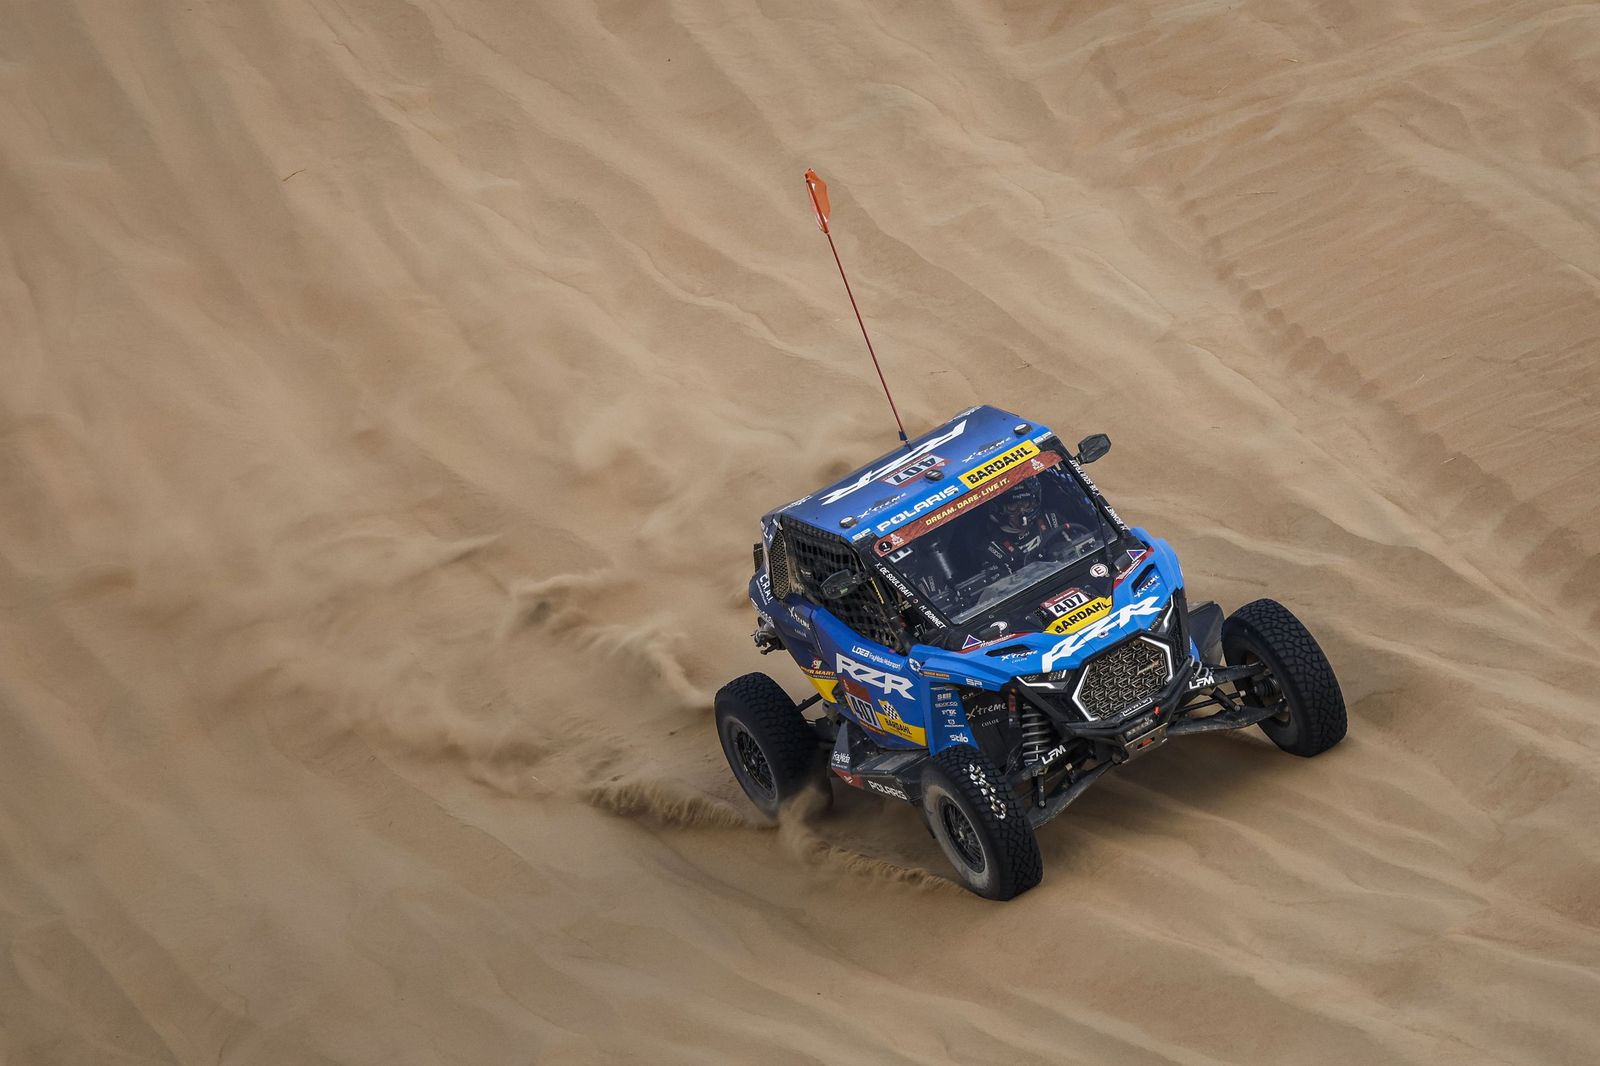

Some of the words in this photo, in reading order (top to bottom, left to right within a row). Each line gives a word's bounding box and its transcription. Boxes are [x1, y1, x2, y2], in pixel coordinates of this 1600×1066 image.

[818, 420, 967, 505] RZR
[893, 457, 936, 484] 407
[966, 446, 1033, 484] BARDAHL
[876, 485, 959, 532] POLARIS
[926, 508, 956, 525] DREAM.
[957, 493, 981, 509] DARE.
[982, 483, 999, 496] LIVE
[999, 478, 1010, 488] IT.
[880, 567, 889, 577] DE
[886, 573, 914, 598] SOULTRAIT
[1055, 593, 1085, 614] 407
[1055, 601, 1112, 633] BARDAHL
[924, 611, 947, 629] BONNET
[1042, 597, 1163, 673] RZR
[836, 653, 916, 700] RZR
[1189, 676, 1215, 689] LFM
[1042, 745, 1066, 765] LFM
[868, 780, 907, 800] POLARIS
